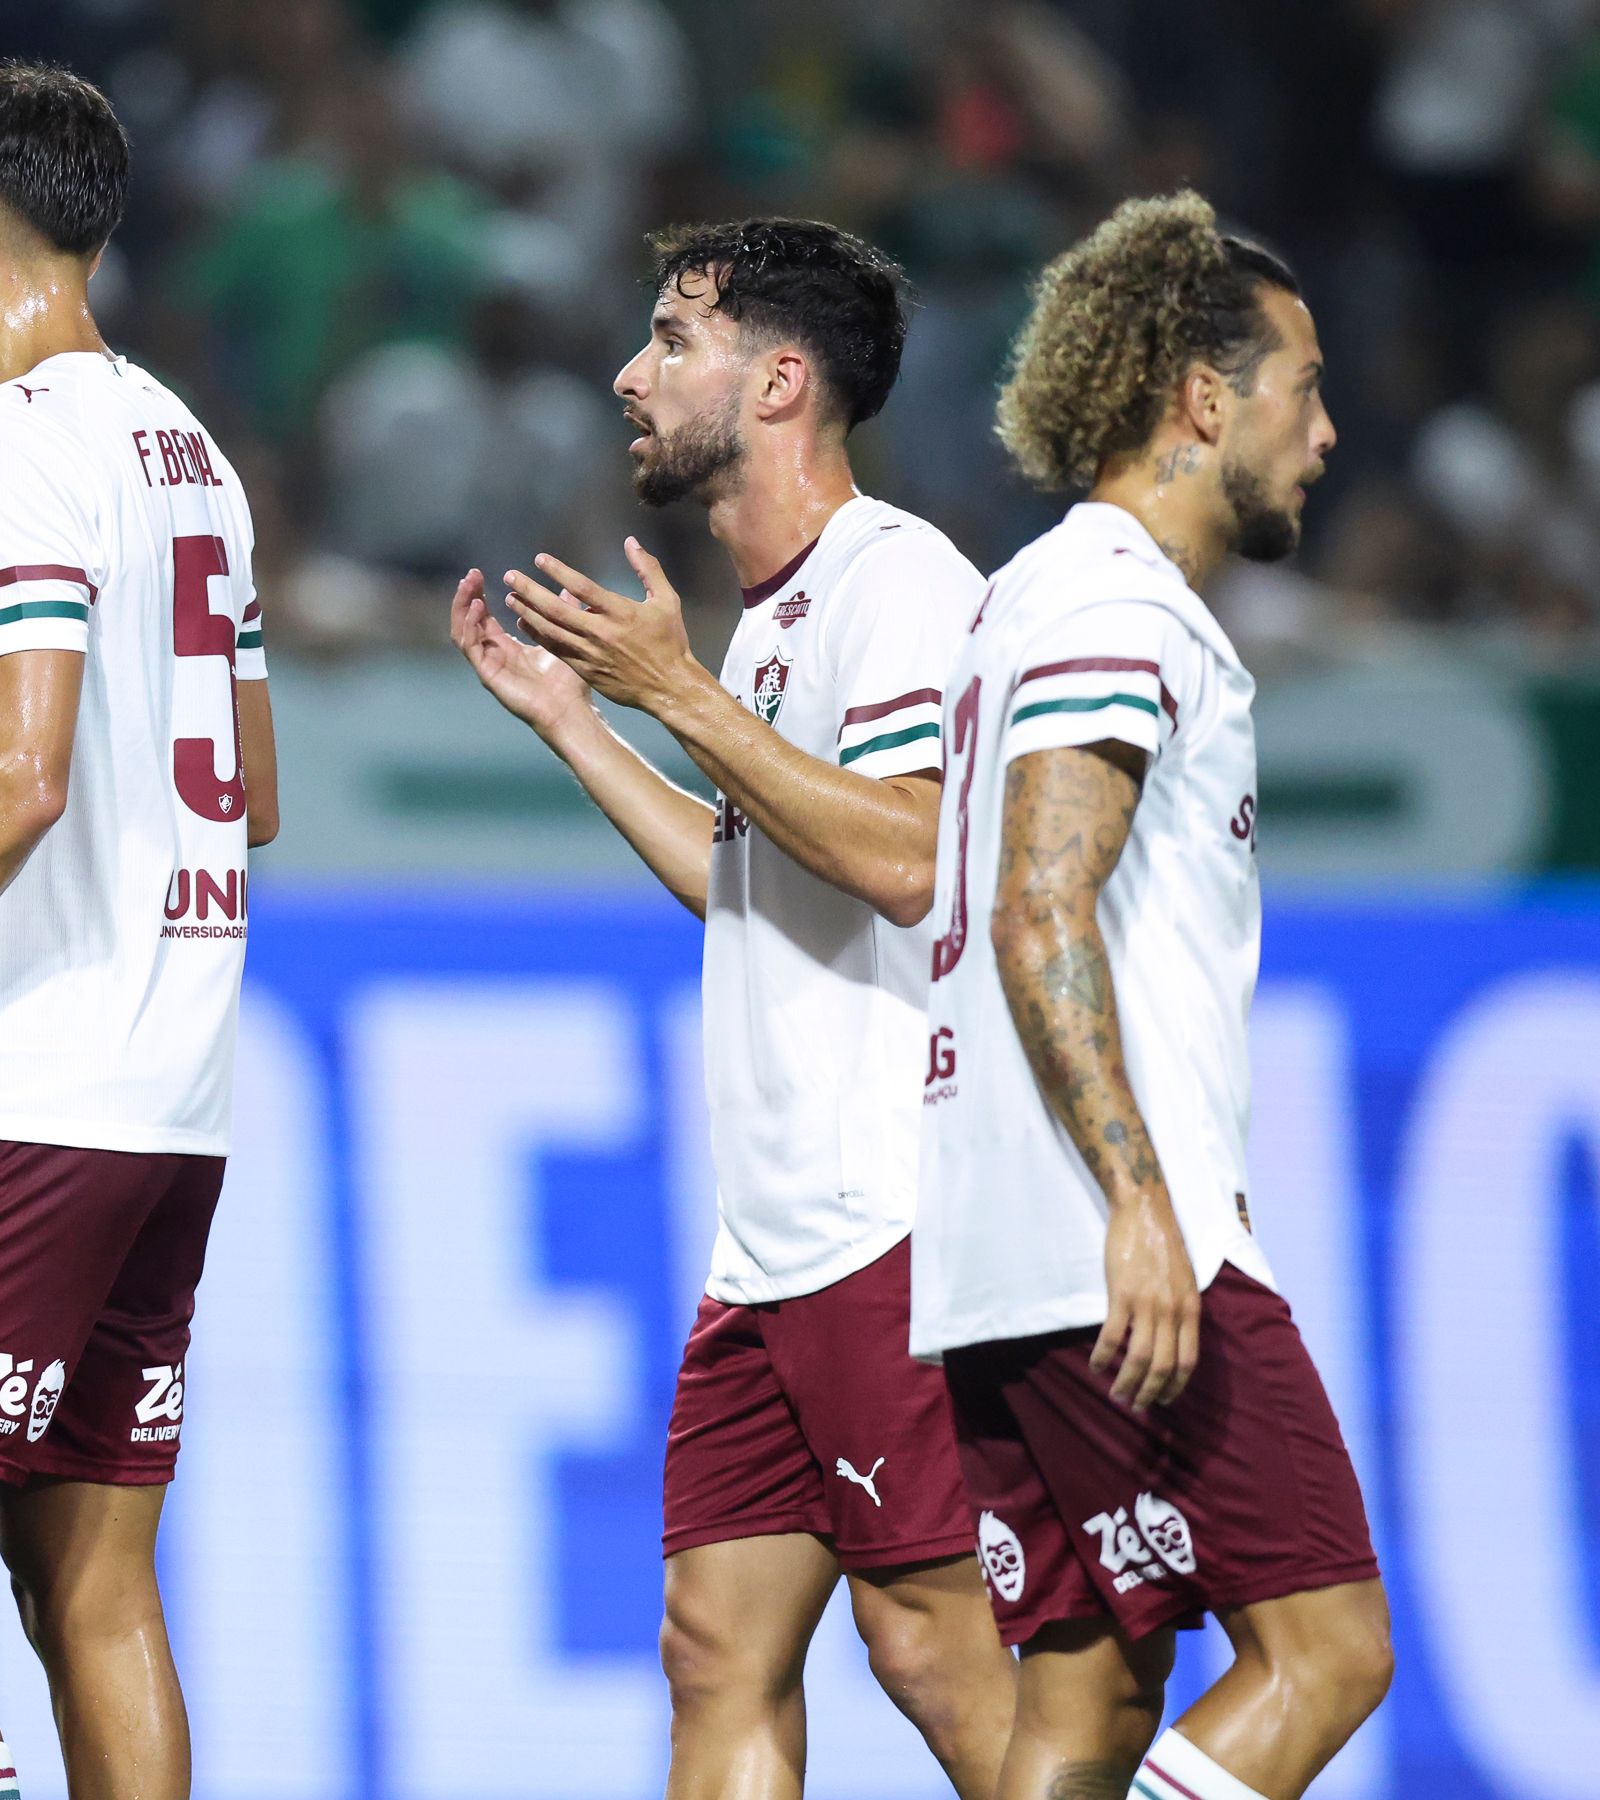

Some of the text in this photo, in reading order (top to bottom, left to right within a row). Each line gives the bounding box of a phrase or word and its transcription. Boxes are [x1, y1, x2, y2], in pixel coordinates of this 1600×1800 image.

[173, 534, 247, 823] 5
[163, 868, 248, 921] UNI
[134, 1361, 183, 1425] Zé
[1081, 1505, 1152, 1575] Zé
